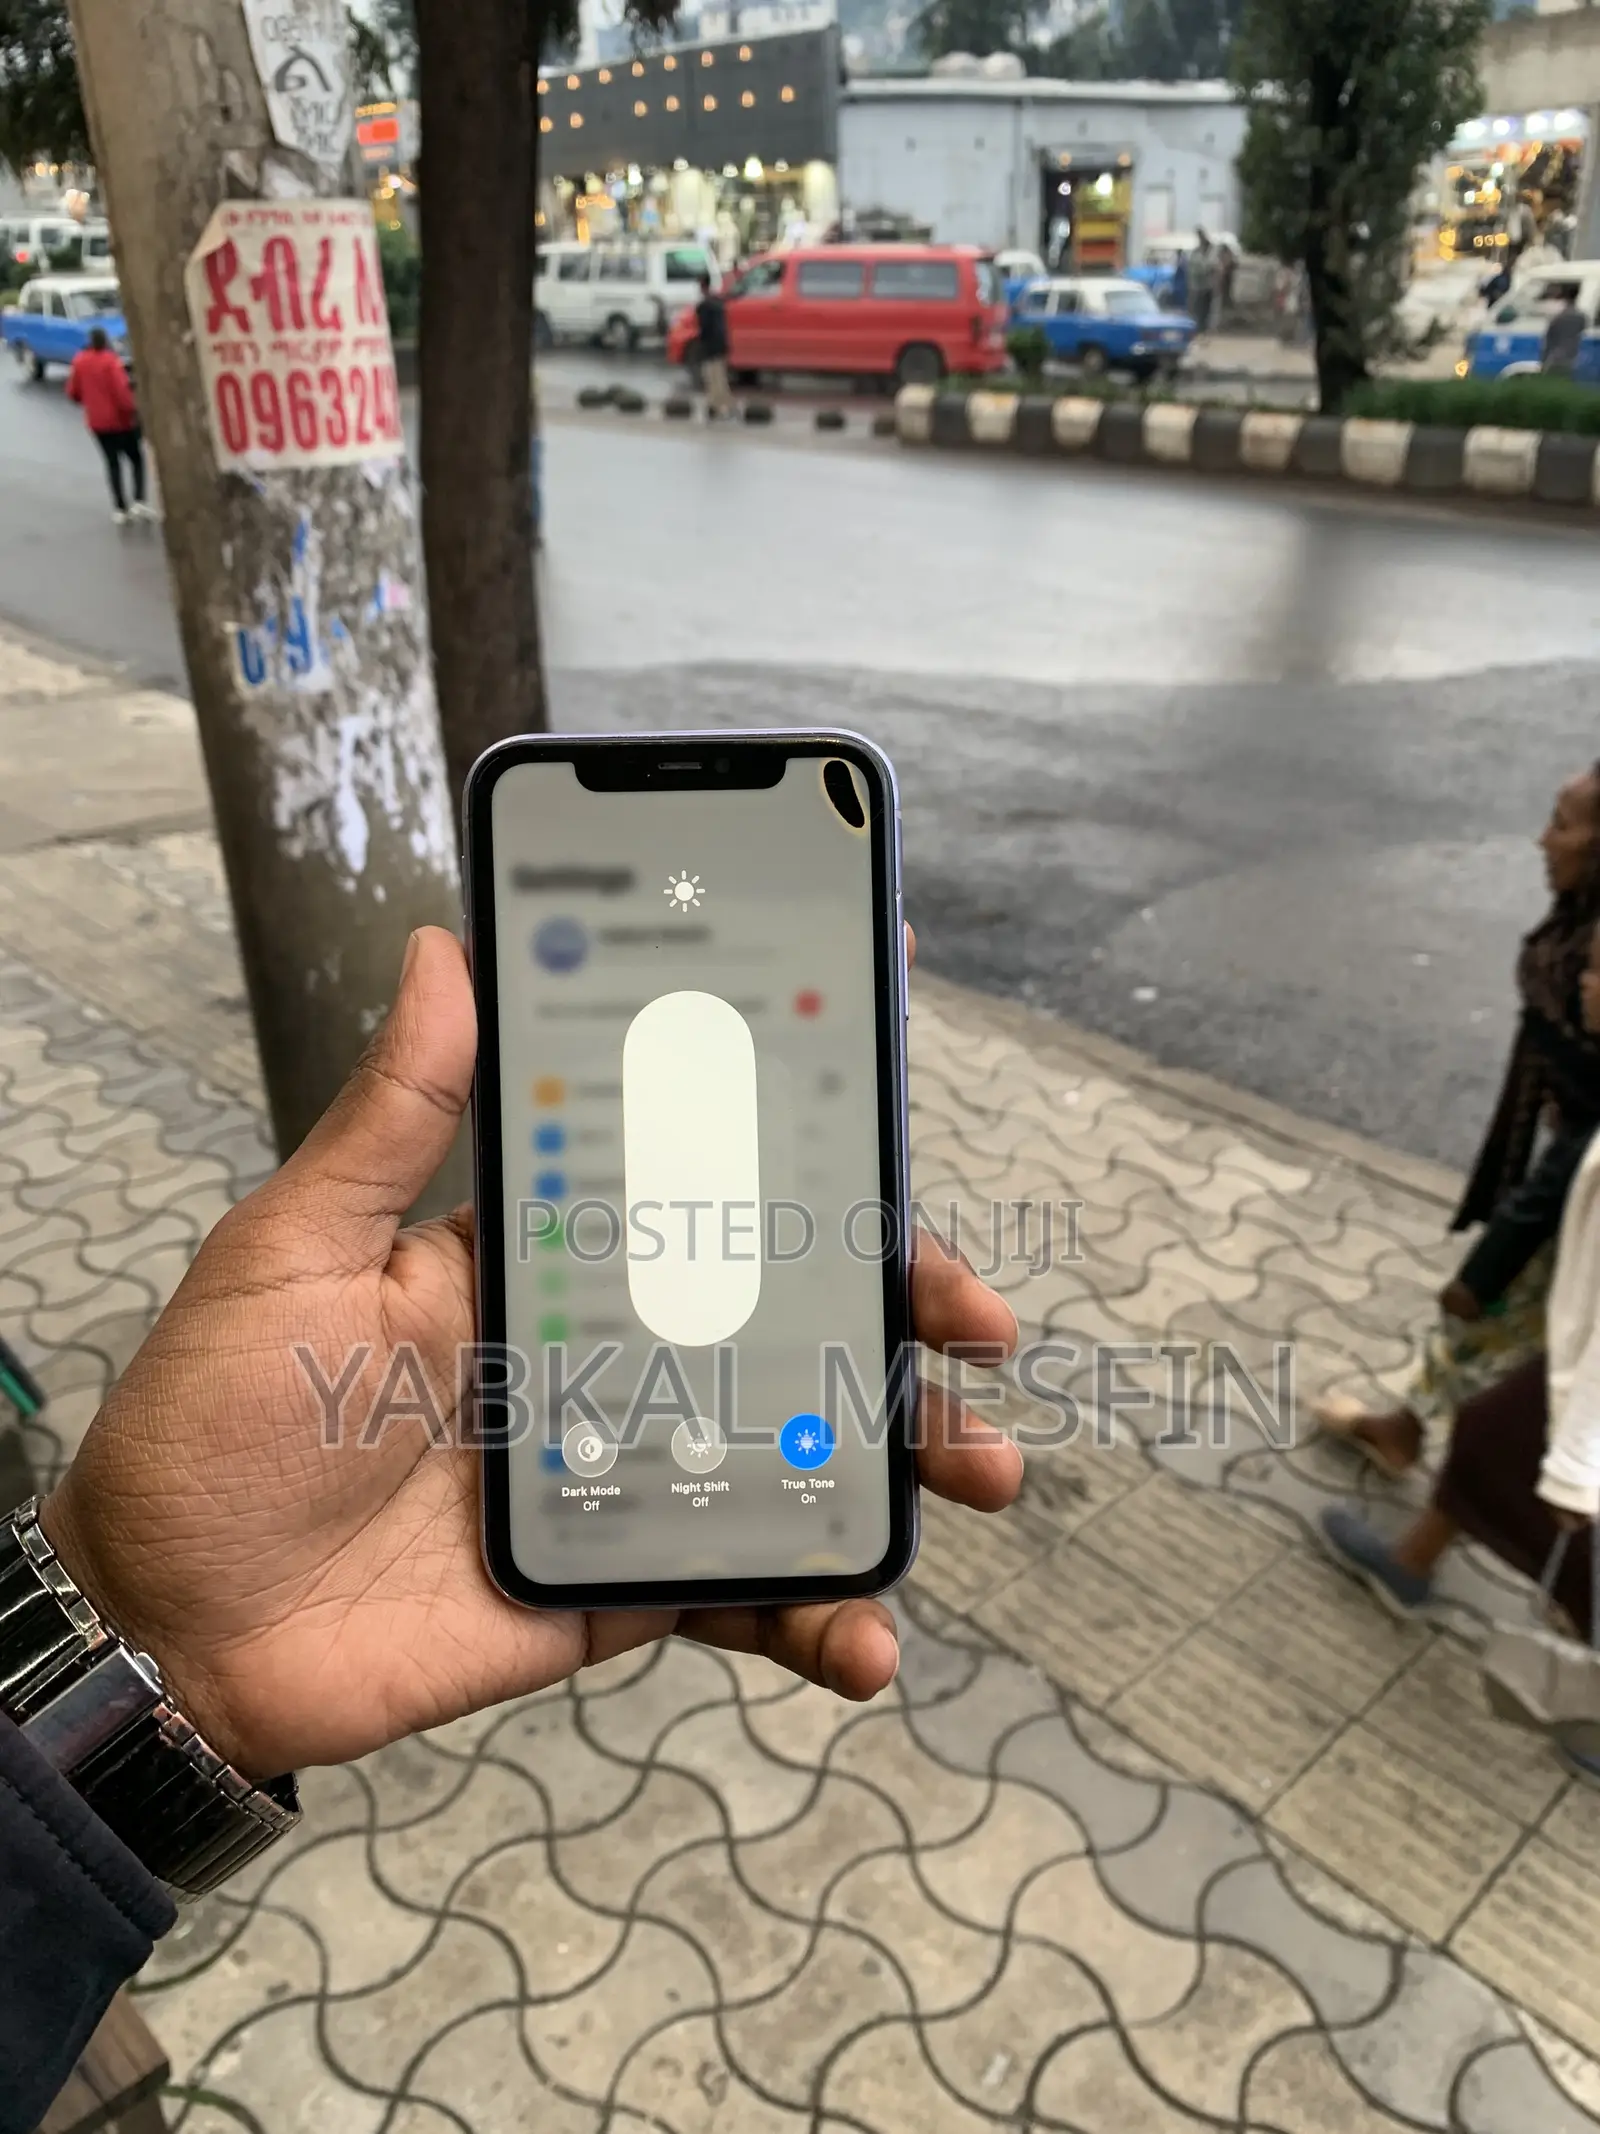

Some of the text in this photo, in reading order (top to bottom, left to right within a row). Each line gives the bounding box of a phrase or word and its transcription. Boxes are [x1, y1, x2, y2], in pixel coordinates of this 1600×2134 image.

[671, 1481, 730, 1495] Night Shift
[781, 1478, 836, 1490] True Tone
[561, 1485, 621, 1498] Dark Mode
[692, 1496, 710, 1508] Off
[801, 1493, 817, 1505] On
[583, 1500, 600, 1512] Off
